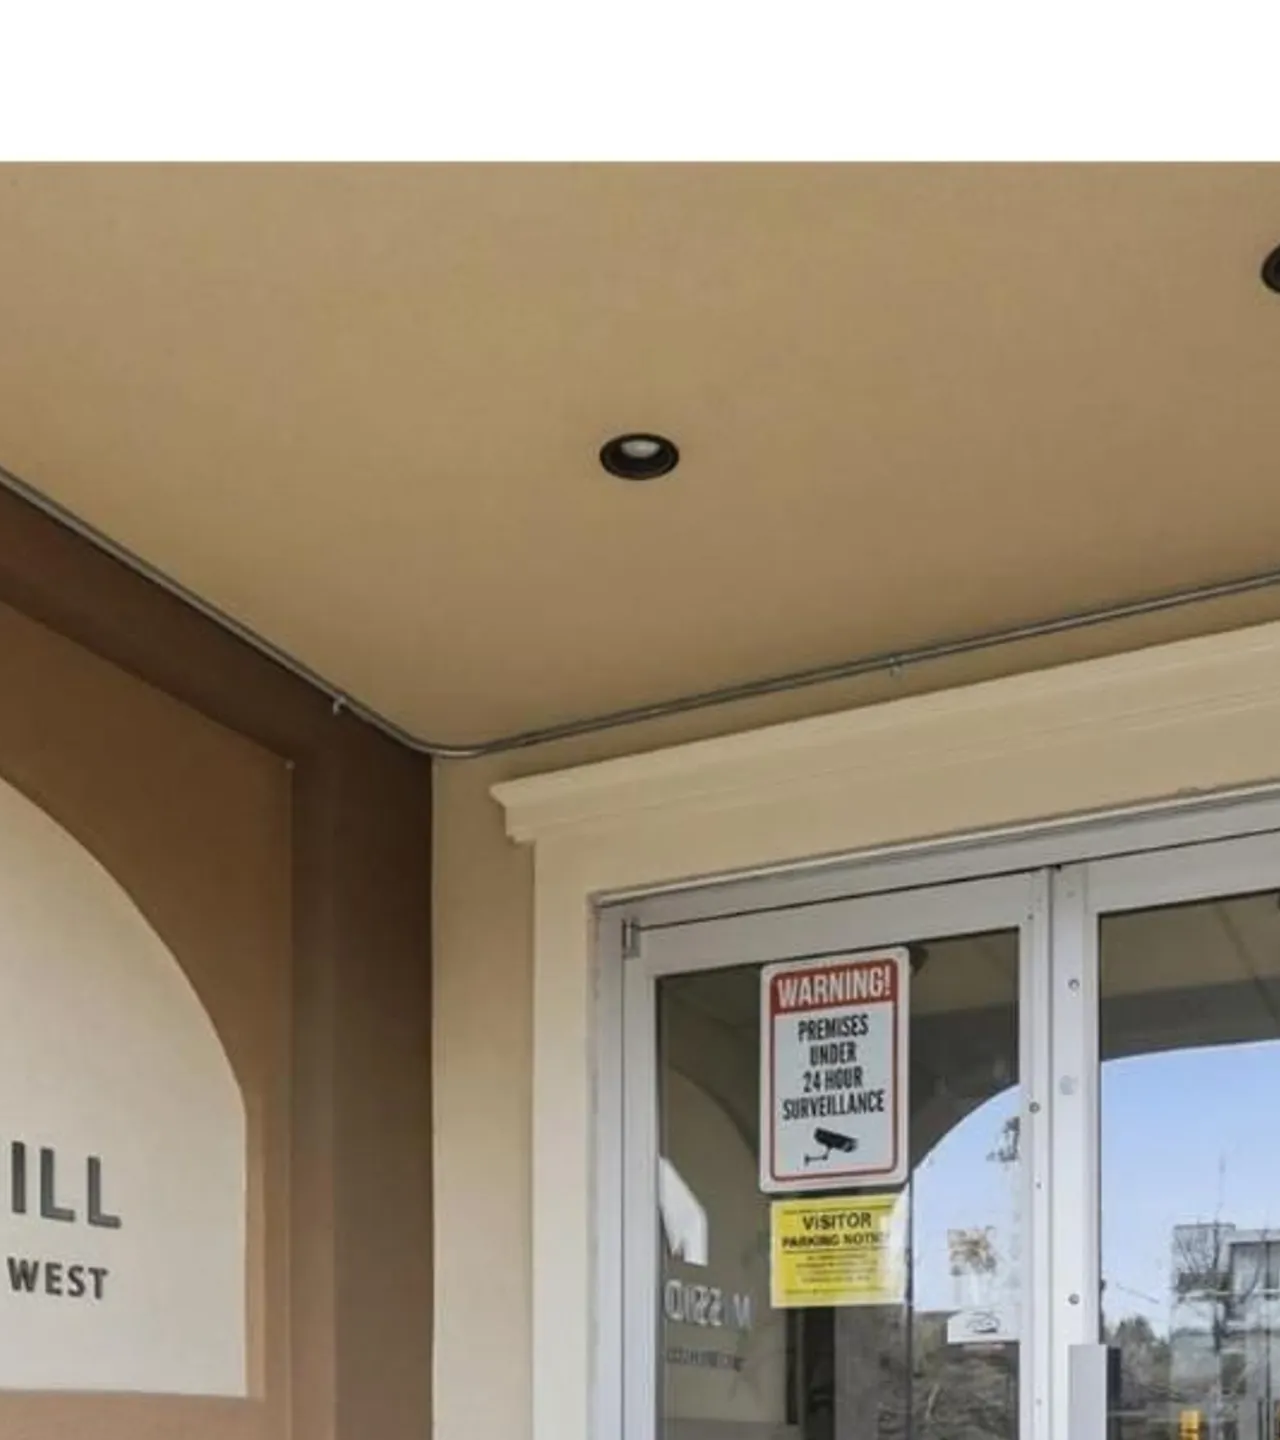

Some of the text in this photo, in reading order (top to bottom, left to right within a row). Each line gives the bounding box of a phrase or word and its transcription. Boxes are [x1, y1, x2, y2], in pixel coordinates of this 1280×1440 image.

[777, 965, 891, 1009] WARNING!
[798, 1014, 869, 1042] PREMISES
[810, 1041, 856, 1067] UNDER
[803, 1066, 863, 1093] 24 HOUR
[782, 1089, 885, 1120] SURVEILLANCE
[802, 1212, 872, 1231] VISITOR
[781, 1234, 839, 1249] PARKING
[8, 1257, 109, 1300] WEST
